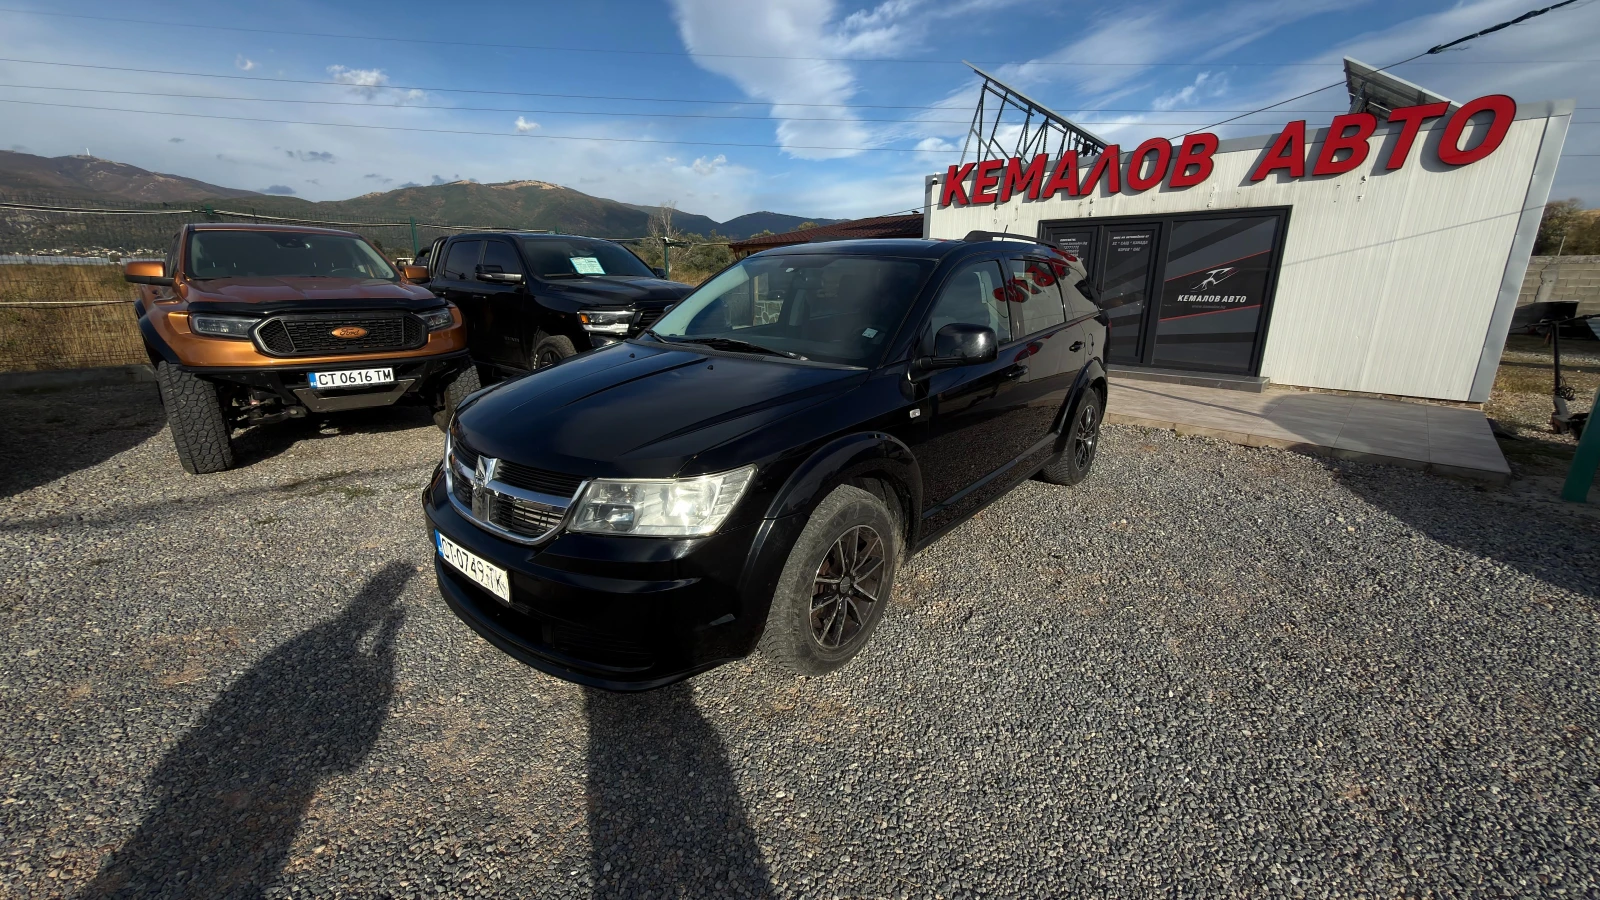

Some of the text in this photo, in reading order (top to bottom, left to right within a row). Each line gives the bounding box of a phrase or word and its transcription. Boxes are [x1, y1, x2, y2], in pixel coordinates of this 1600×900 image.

[942, 95, 1517, 206] КЕМАЛОВ АВТО
[1177, 294, 1247, 303] КЕМАЛОВ АВТО
[340, 328, 360, 336] Ford
[318, 373, 337, 386] CT
[339, 370, 373, 384] 0616
[373, 369, 392, 381] TM
